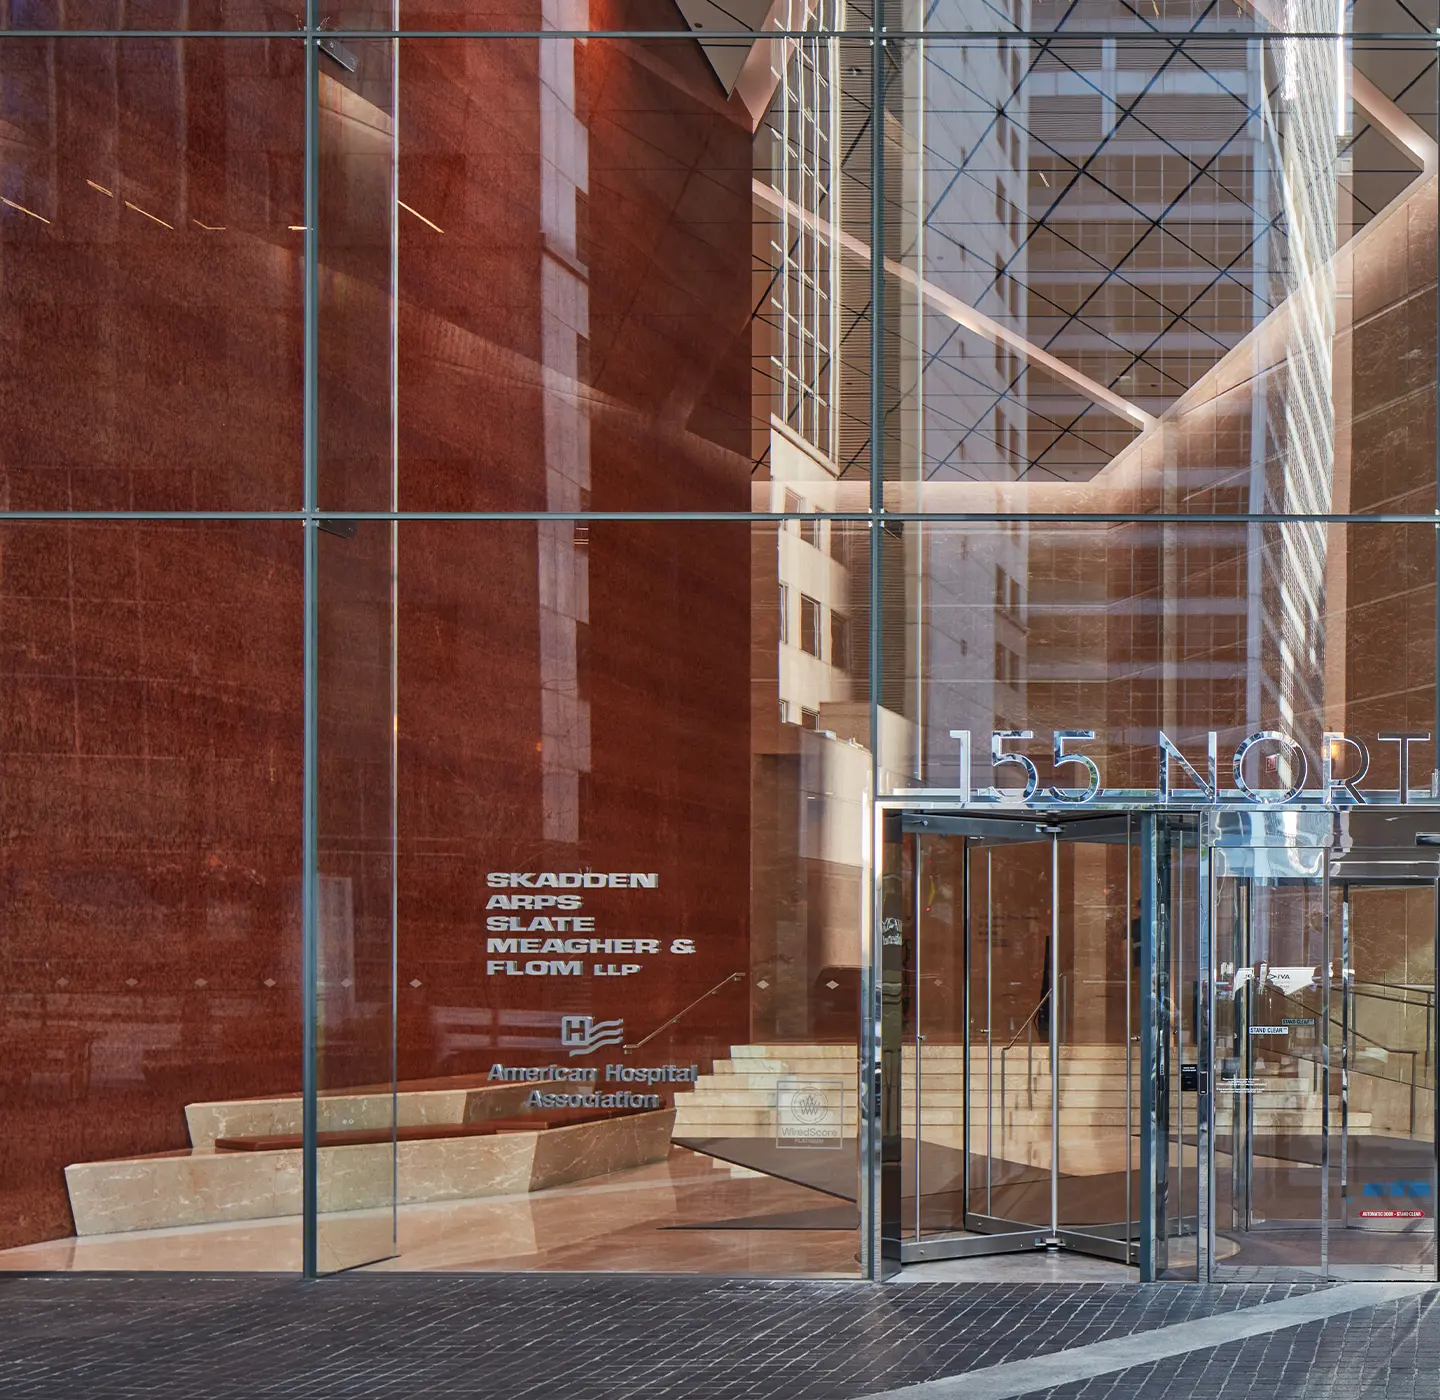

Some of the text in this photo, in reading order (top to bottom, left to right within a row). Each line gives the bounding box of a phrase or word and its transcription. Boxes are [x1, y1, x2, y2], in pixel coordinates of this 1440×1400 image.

[948, 729, 1101, 805] 155
[486, 872, 659, 889] SKADDEN
[485, 894, 584, 910] ARPS
[486, 915, 596, 932] SLATE
[486, 937, 697, 954] MEAGHER &
[486, 960, 643, 976] FLOM LLP
[487, 1063, 698, 1085] American Hospital
[525, 1090, 661, 1109] Association
[781, 1127, 838, 1137] WiredScore
